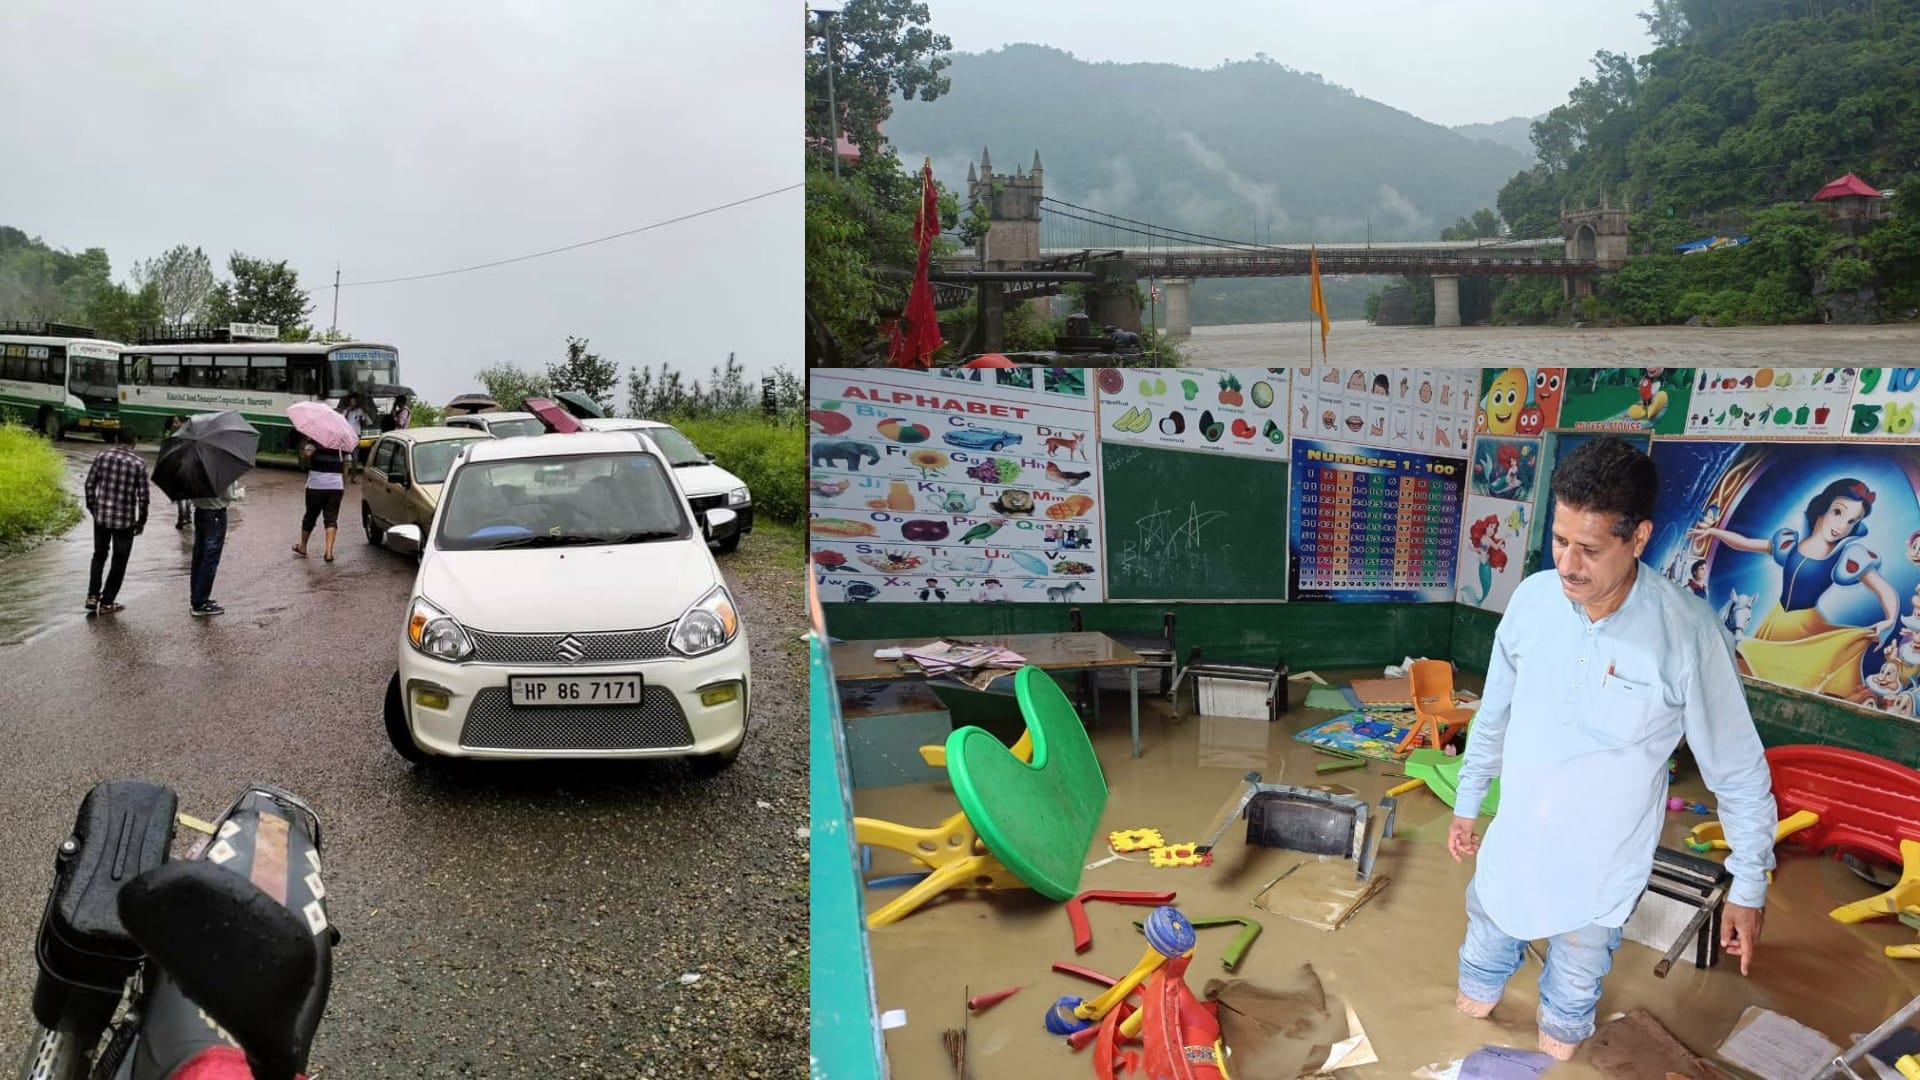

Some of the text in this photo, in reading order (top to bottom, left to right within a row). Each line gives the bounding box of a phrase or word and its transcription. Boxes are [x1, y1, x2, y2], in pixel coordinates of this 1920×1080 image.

[842, 386, 1030, 420] ALPHABET
[1850, 402, 1915, 435] 15 16
[1307, 449, 1397, 469] Numbers
[1403, 460, 1411, 471] 1
[1426, 463, 1455, 475] 100
[525, 683, 547, 700] HP
[558, 682, 580, 700] 86
[590, 681, 635, 700] 7171
